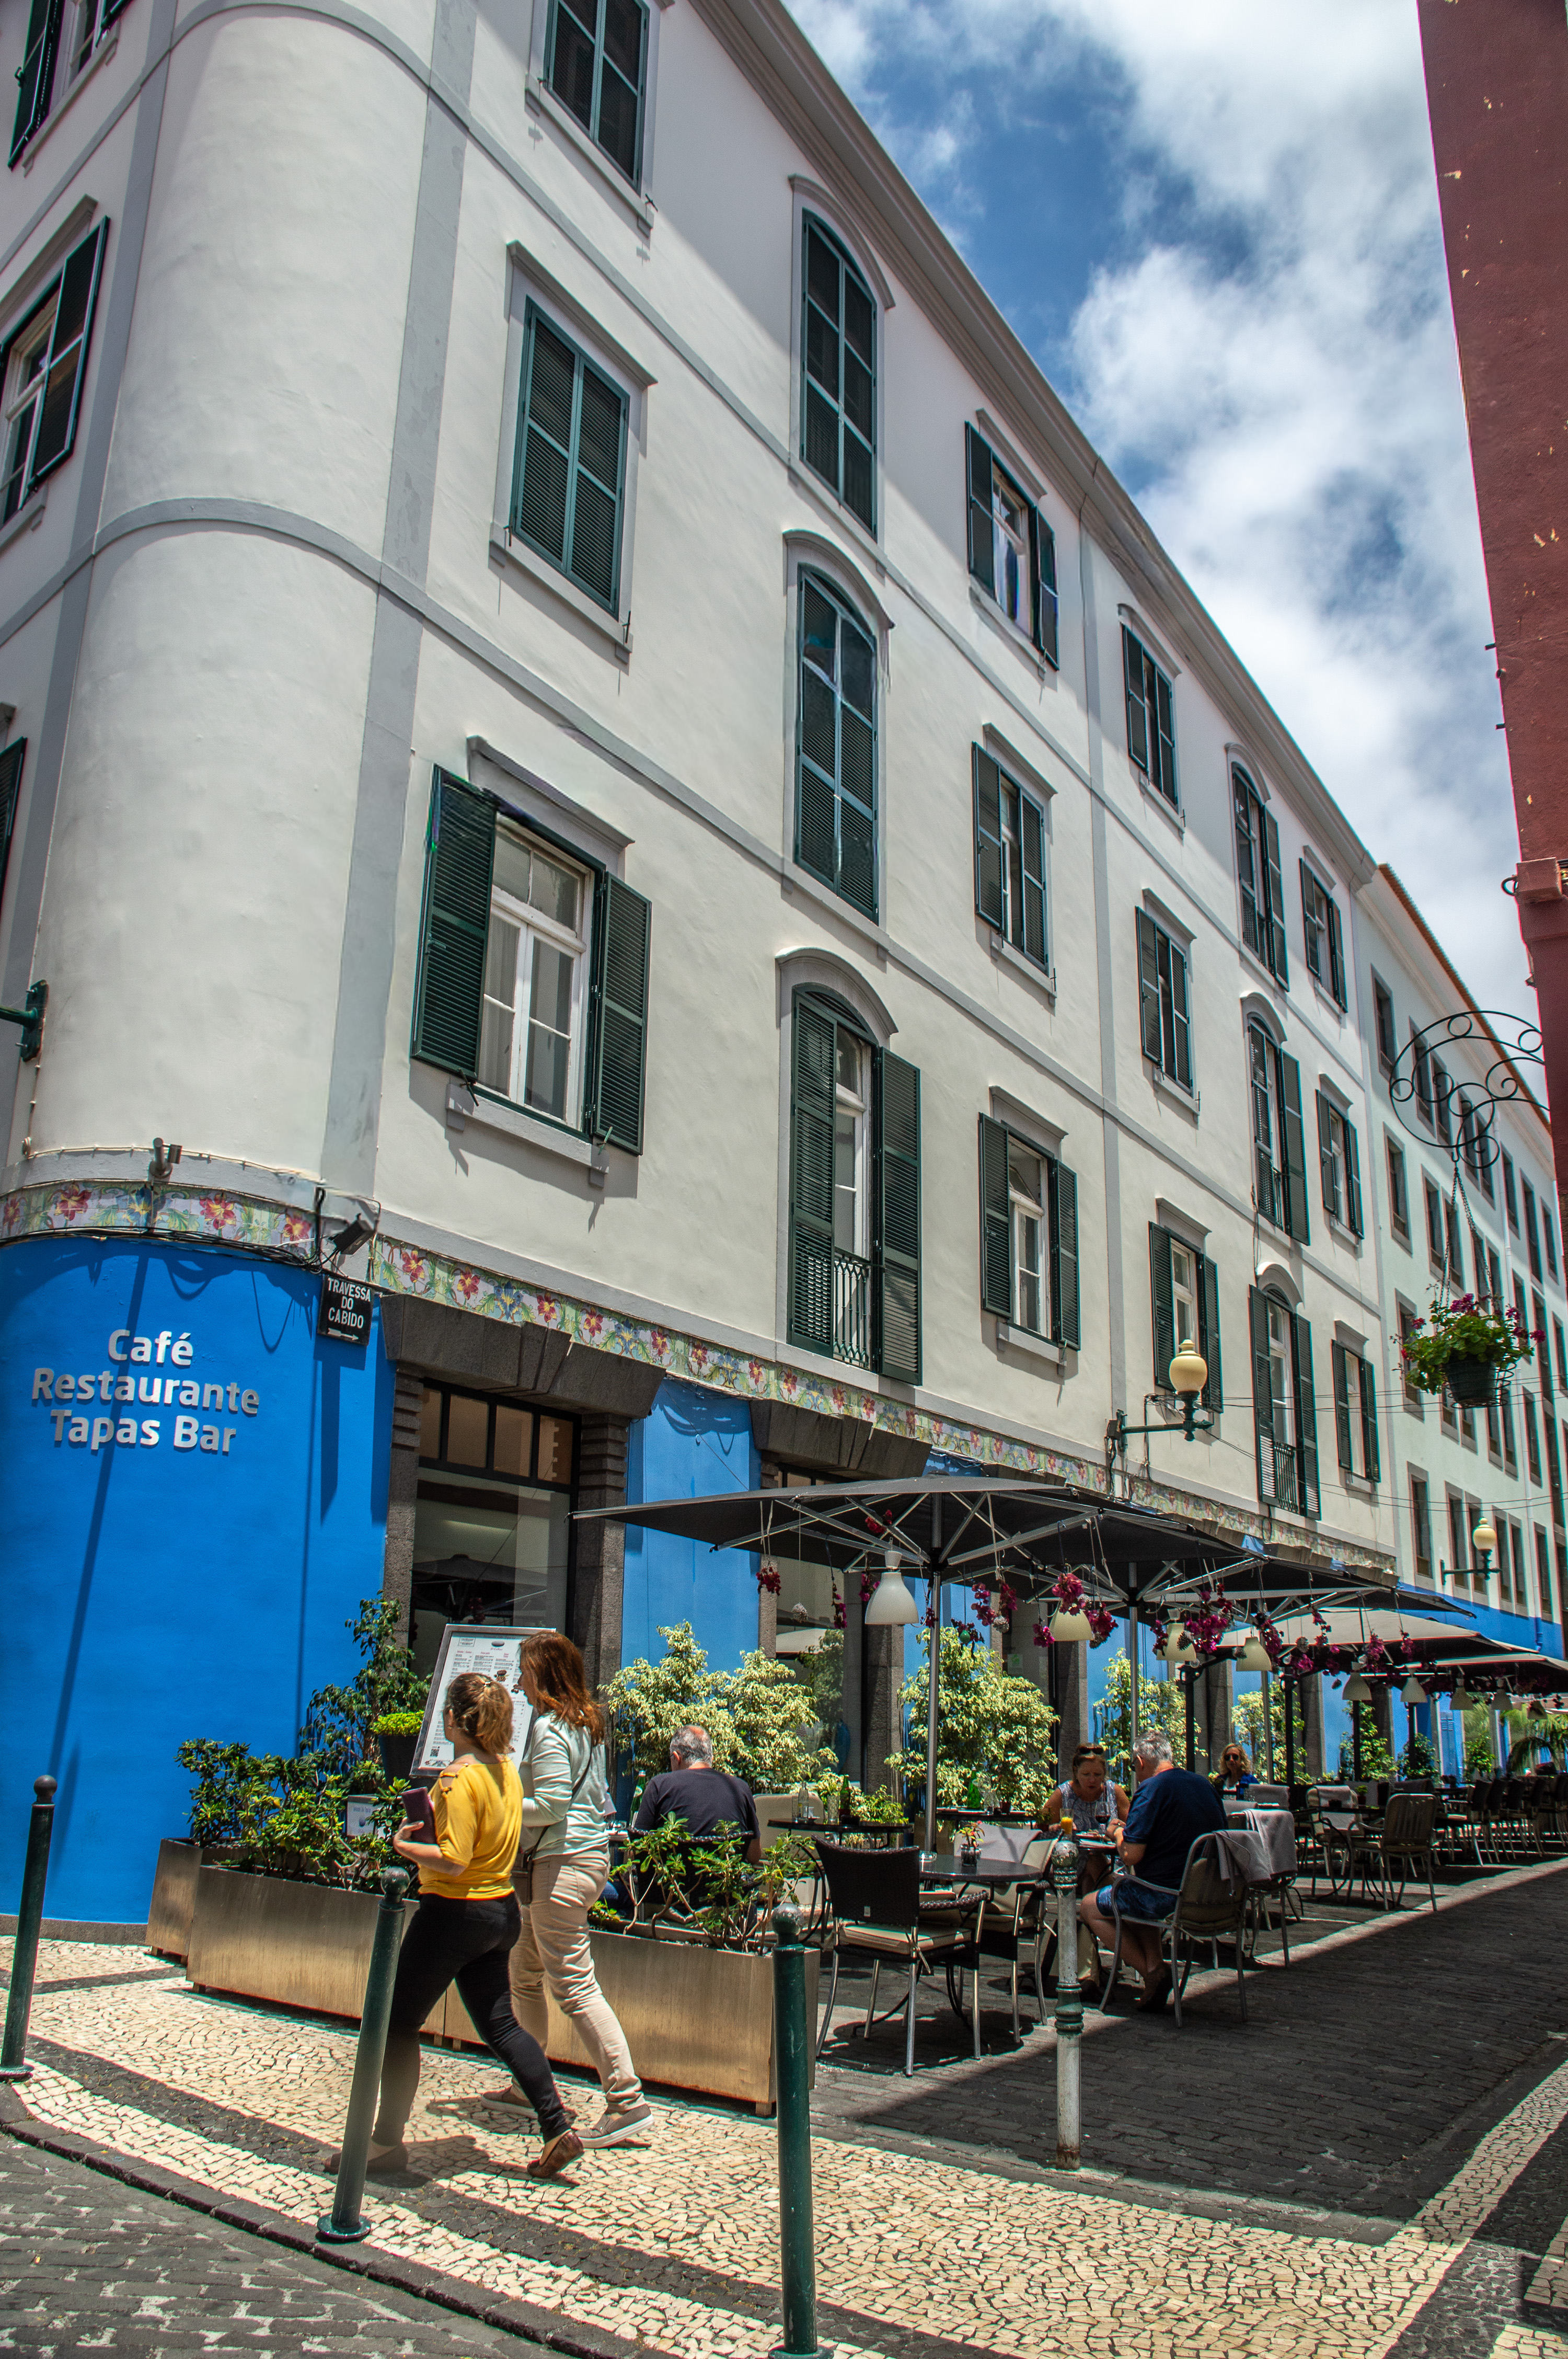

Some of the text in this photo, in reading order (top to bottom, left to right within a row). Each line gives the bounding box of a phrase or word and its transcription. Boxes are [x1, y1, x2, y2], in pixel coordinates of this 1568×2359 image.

[328, 1278, 371, 1302] TRAVESSA
[341, 1296, 354, 1310] DO
[328, 1307, 364, 1329] CABIDO
[108, 1329, 193, 1366] Café
[32, 1368, 259, 1414] Restaurante
[50, 1410, 236, 1452] Tapas Bar
